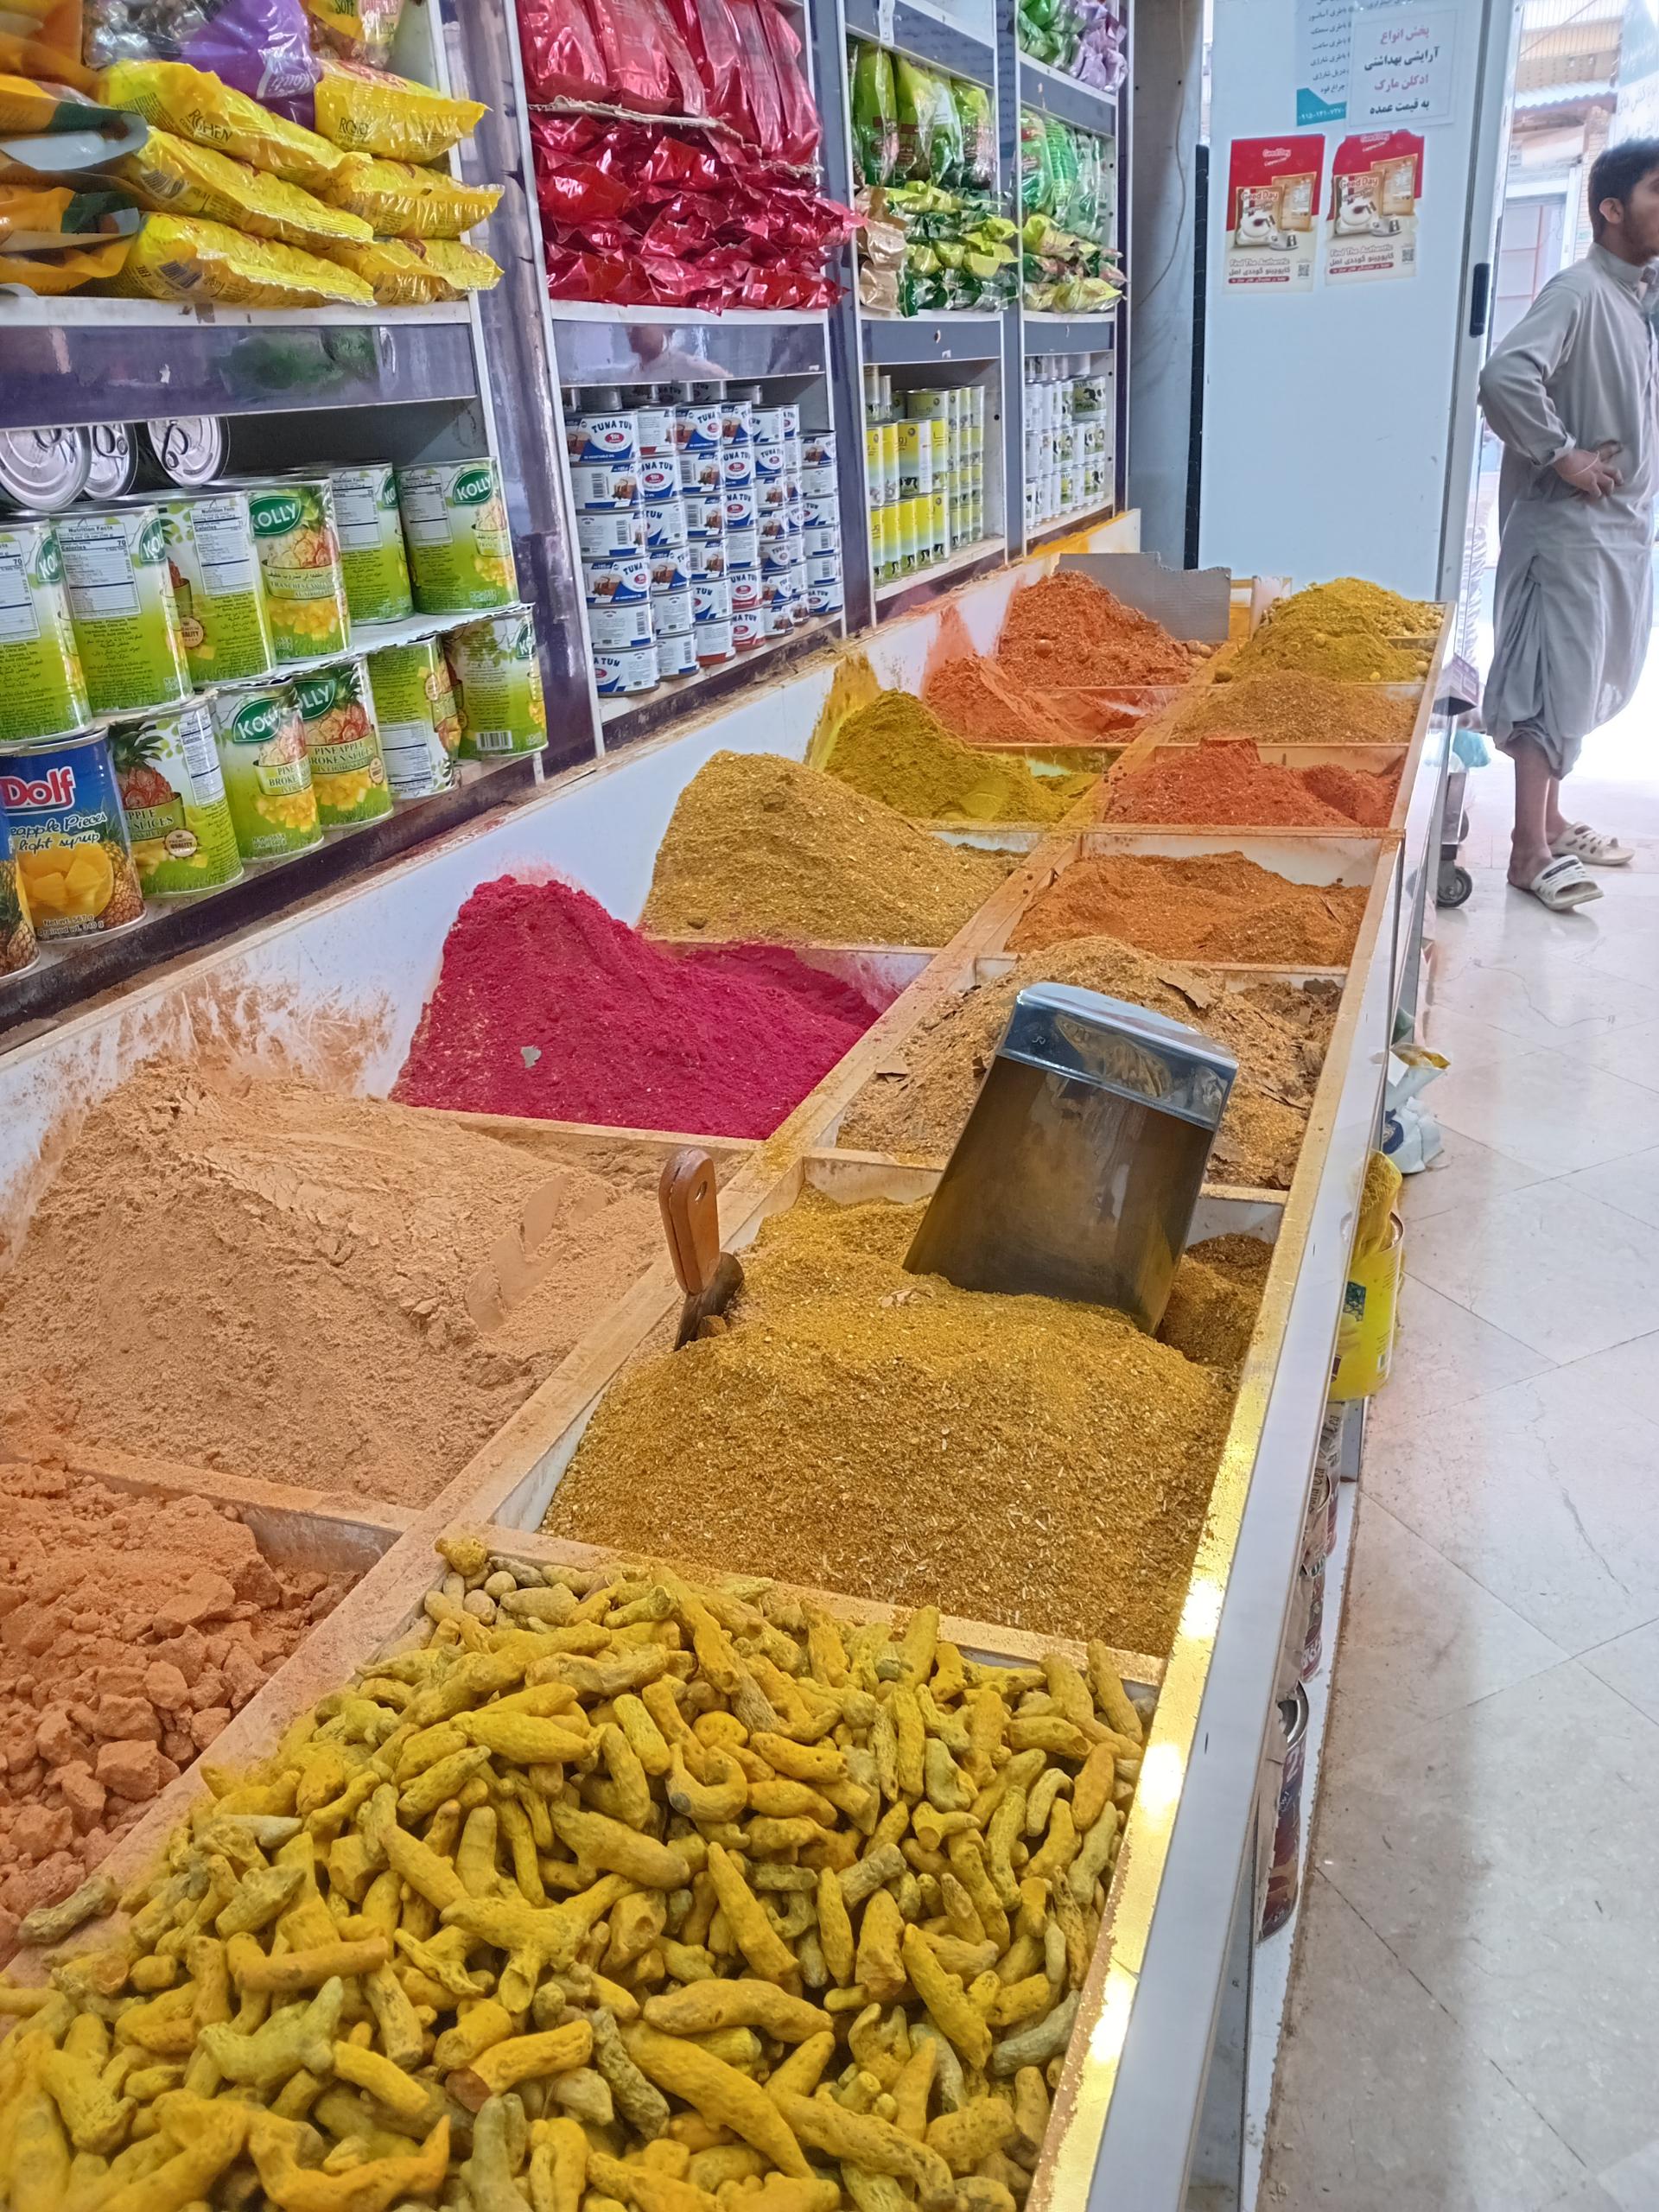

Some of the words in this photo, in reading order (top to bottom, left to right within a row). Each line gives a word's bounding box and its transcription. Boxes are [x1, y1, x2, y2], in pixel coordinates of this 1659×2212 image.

[1381, 29, 1404, 44] انواع
[1364, 55, 1402, 71] بهداشتی
[1404, 47, 1440, 66] آرایشی
[1375, 78, 1399, 92] مارک
[1402, 74, 1428, 90] ادکلن
[1370, 105, 1393, 114] عمده
[1395, 99, 1419, 111] قیمت
[1362, 176, 1379, 187] Day
[1262, 190, 1279, 200] Day
[592, 421, 617, 433] TUNA
[619, 421, 632, 430] TUN
[457, 474, 492, 500] KOLLY
[623, 563, 643, 575] TUNA
[696, 588, 713, 596] TUN
[600, 658, 620, 667] TUN
[302, 684, 331, 709] LLY
[314, 741, 364, 755] PINEAPPLE
[0, 767, 74, 808] Dolf
[11, 819, 59, 841] eapple
[64, 811, 107, 831] Pieces
[19, 836, 53, 855] light
[59, 832, 100, 850] syrup
[98, 920, 105, 929] g
